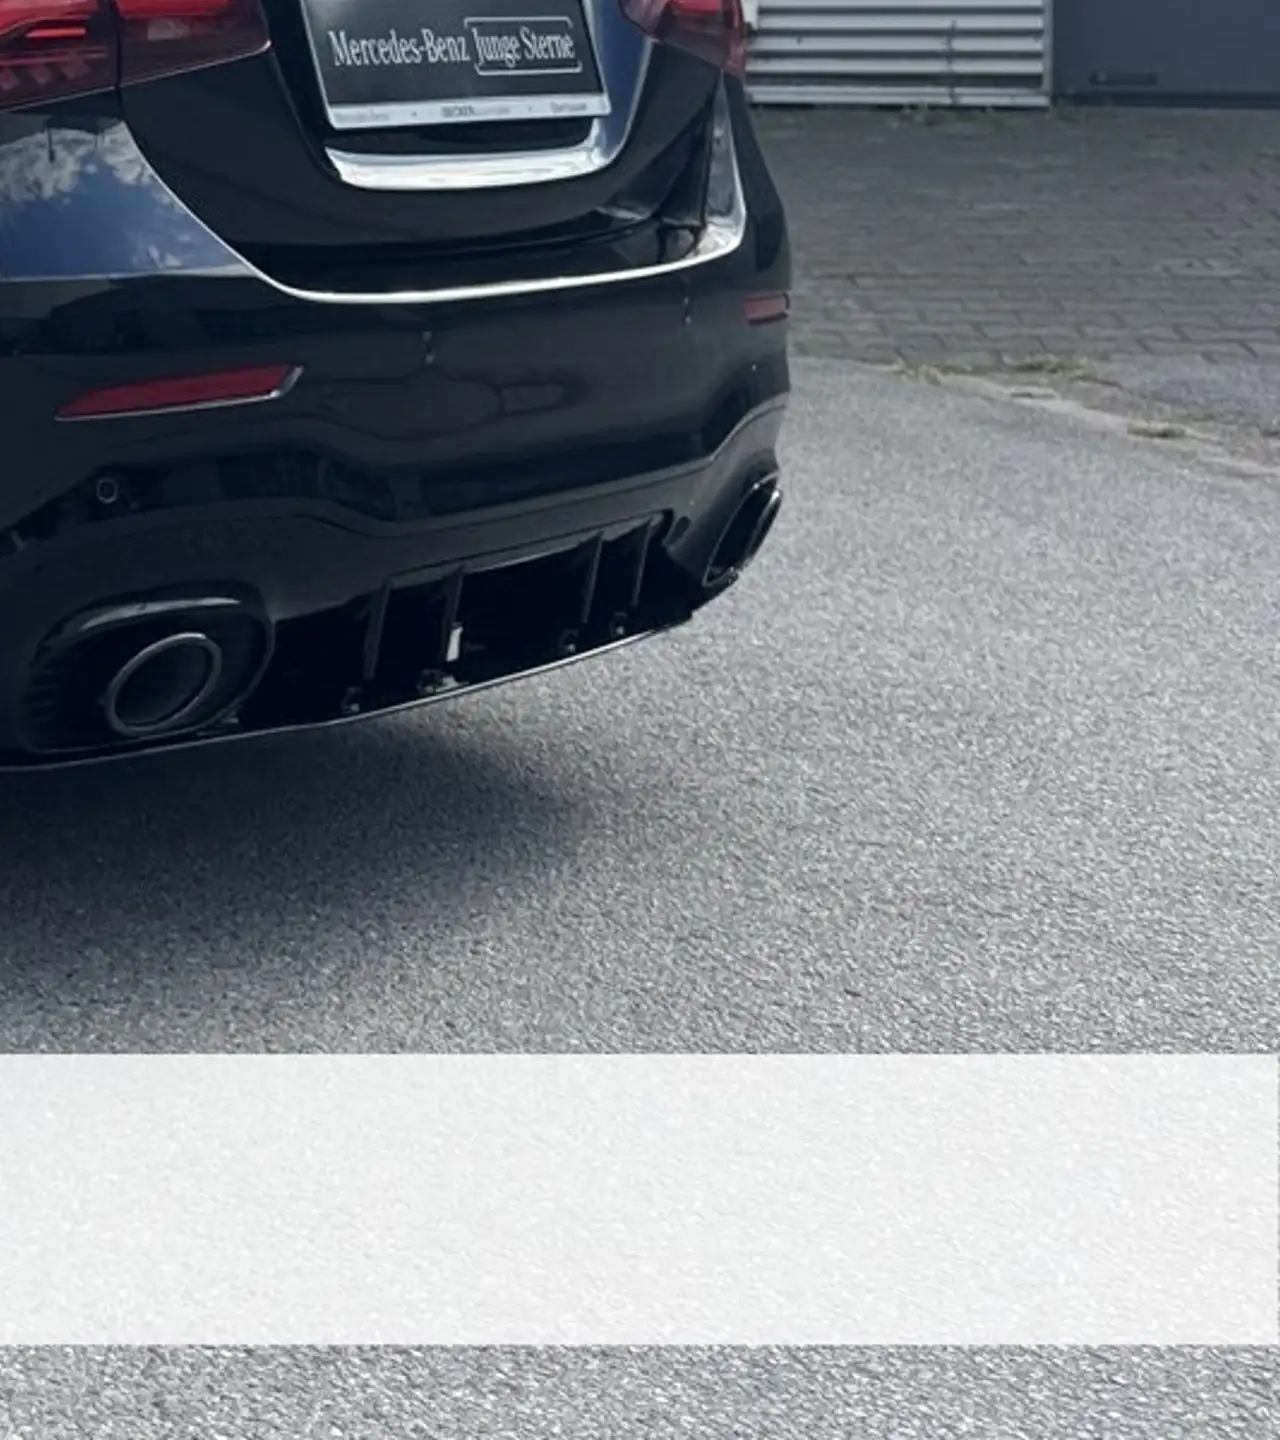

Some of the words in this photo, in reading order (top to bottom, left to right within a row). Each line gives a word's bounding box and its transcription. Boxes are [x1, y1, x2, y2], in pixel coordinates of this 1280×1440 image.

[327, 27, 470, 67] Mercedes-Benz
[471, 26, 520, 68] Junge
[521, 25, 576, 59] Sterne
